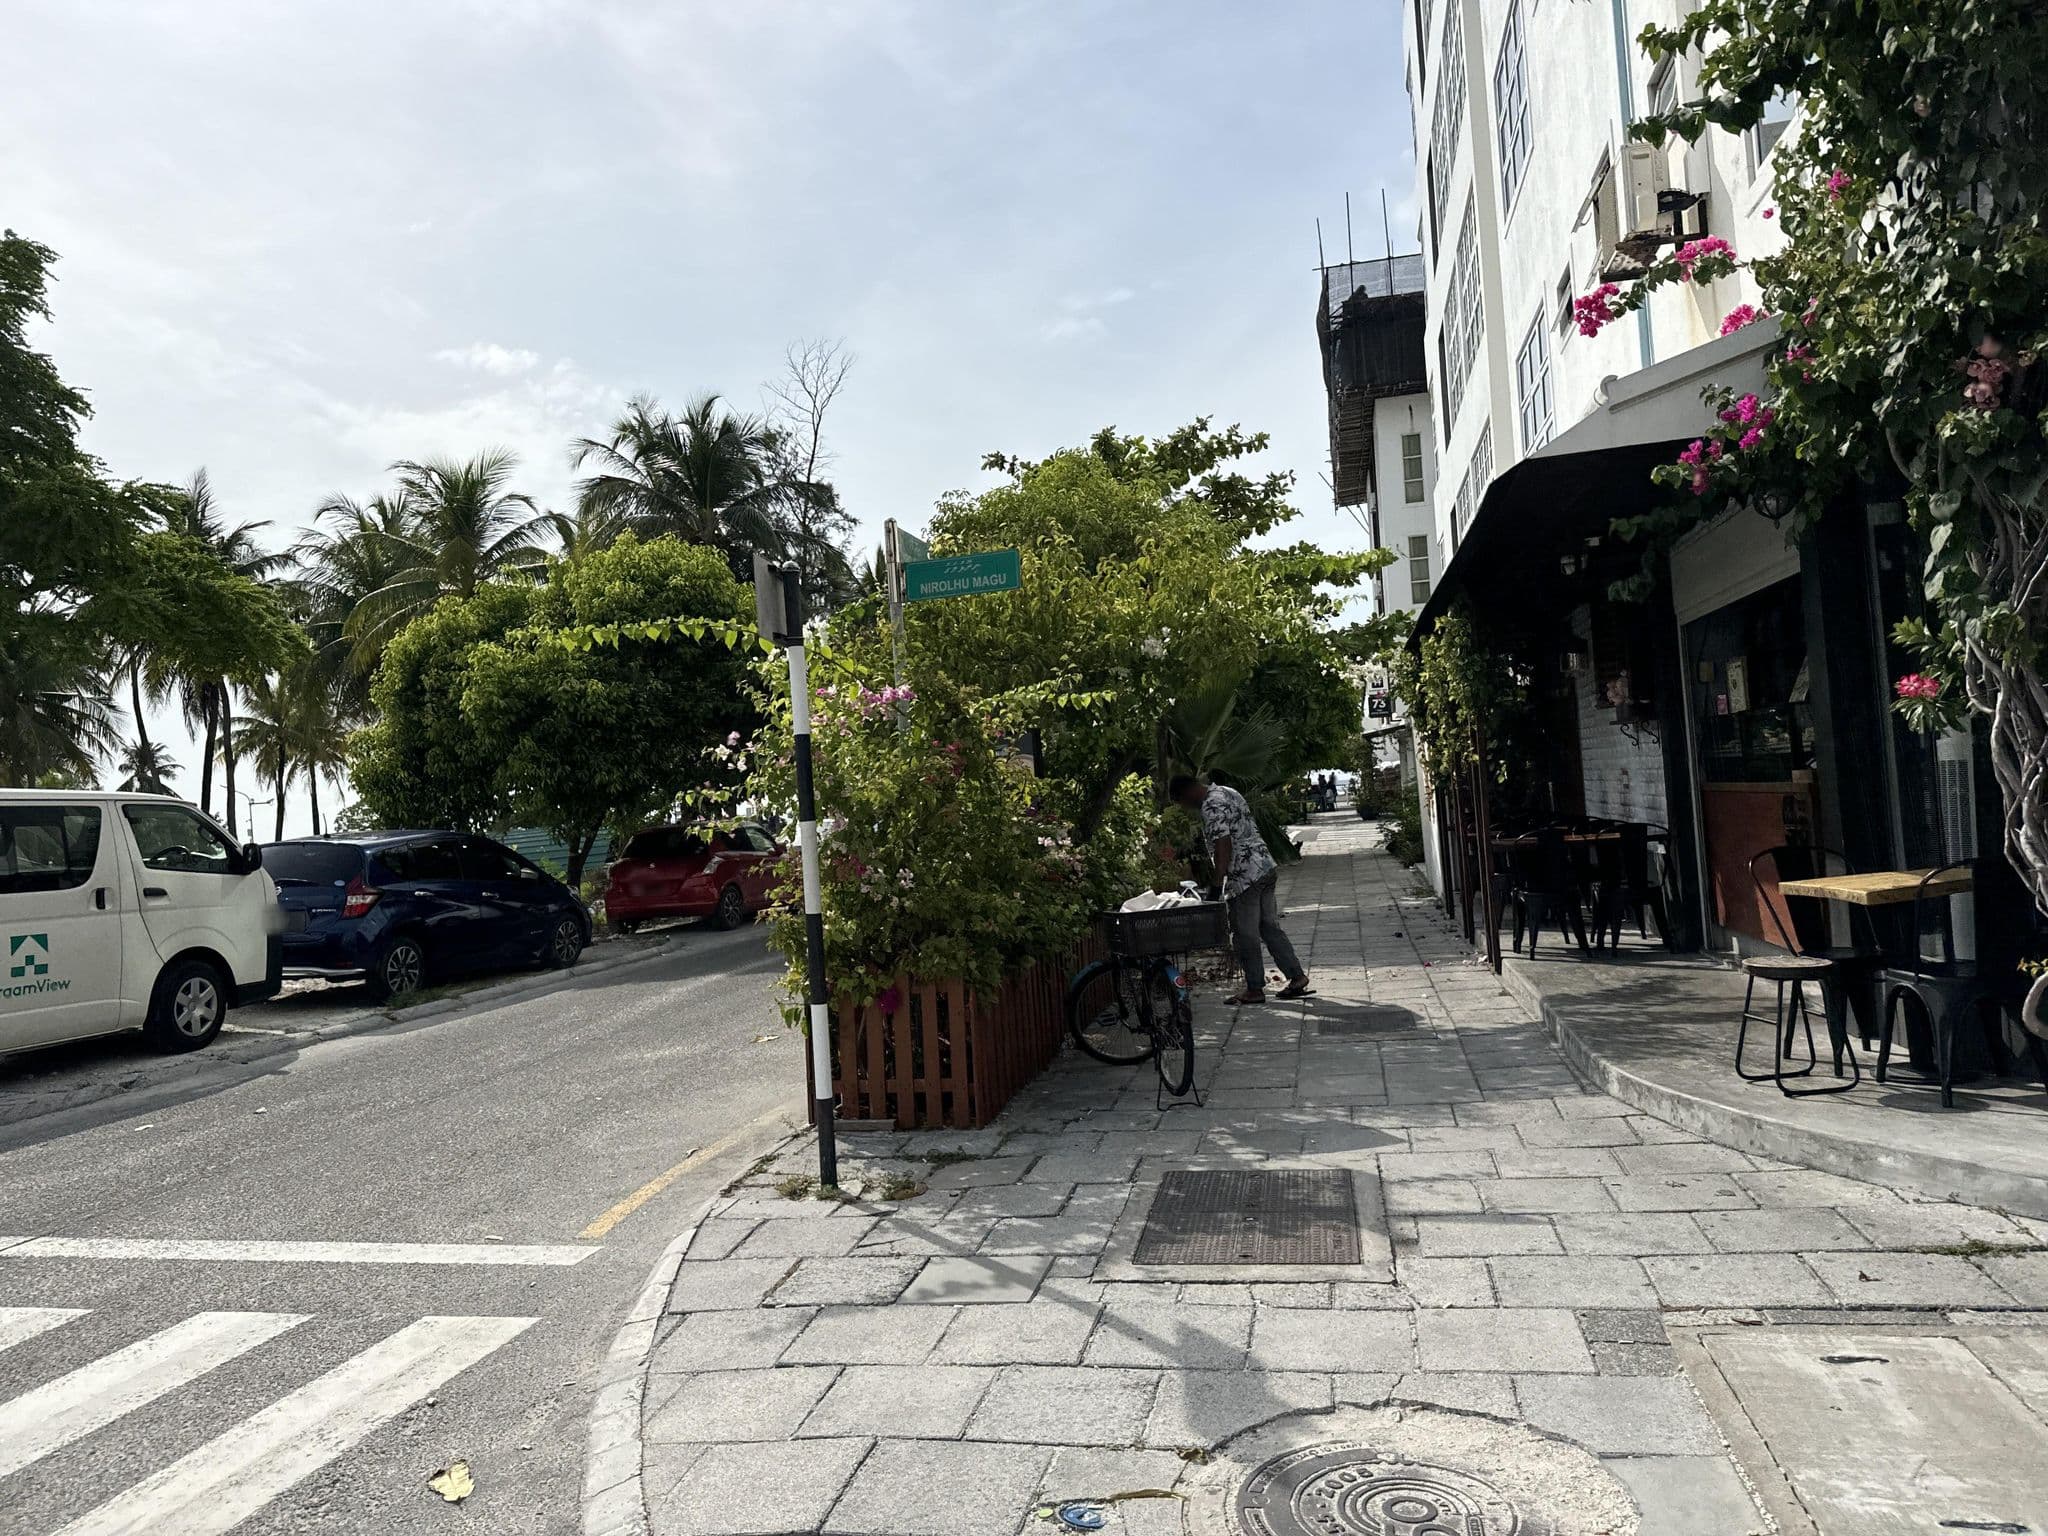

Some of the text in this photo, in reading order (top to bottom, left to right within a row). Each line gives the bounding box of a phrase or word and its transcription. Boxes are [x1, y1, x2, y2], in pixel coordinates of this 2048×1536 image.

[920, 573, 1007, 594] NIROLHU MAGU
[0, 978, 71, 998] aamView
